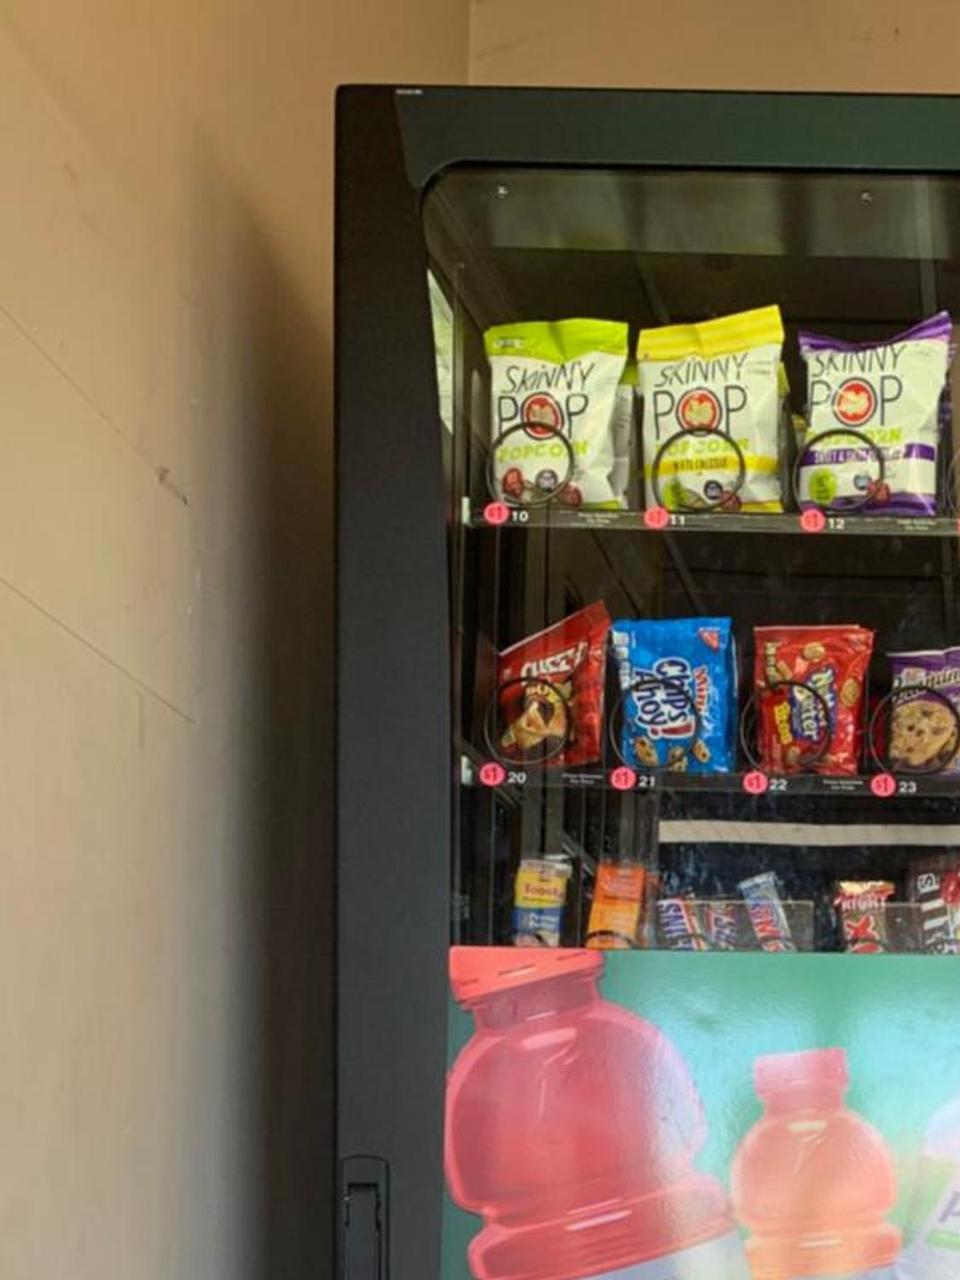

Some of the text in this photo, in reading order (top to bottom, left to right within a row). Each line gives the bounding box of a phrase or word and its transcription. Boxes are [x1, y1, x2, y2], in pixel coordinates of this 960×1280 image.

[511, 509, 530, 522] 10
[827, 517, 846, 530] 12
[507, 771, 527, 785] 20
[638, 775, 656, 788] 21
[769, 778, 788, 792] 22
[899, 780, 918, 793] 23
